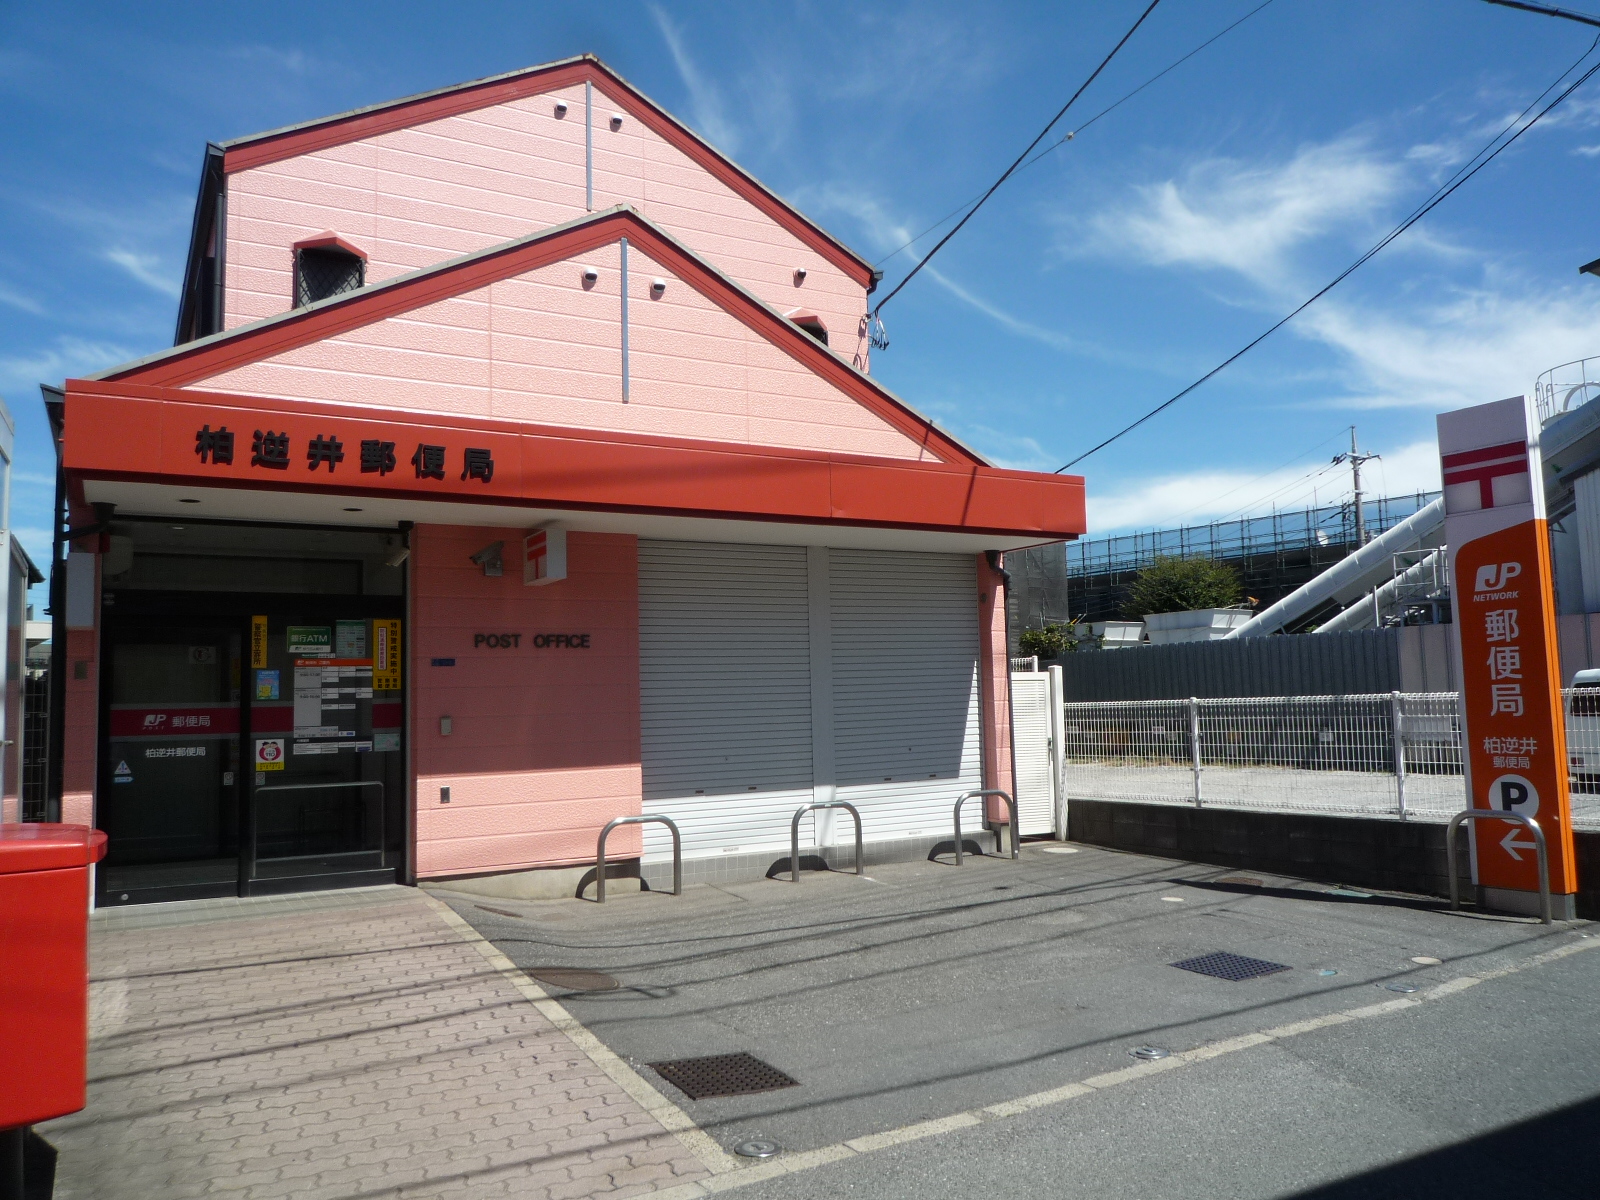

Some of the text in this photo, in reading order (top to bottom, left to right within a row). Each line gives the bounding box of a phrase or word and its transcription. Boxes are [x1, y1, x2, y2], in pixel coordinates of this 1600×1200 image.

[195, 424, 494, 483] 柏逆井郵便局
[1473, 590, 1519, 602] NETWORK
[290, 634, 328, 643] 銀行ATM
[474, 633, 591, 648] POST OFFICE
[390, 621, 398, 675] 特別警戒実施中
[1485, 609, 1524, 717] 郵便局
[172, 715, 211, 728] 郵便局
[145, 746, 206, 758] 柏逆井郵便局
[1483, 736, 1538, 755] 柏逆井
[1493, 756, 1530, 769] 郵便局
[1500, 781, 1529, 811] P
